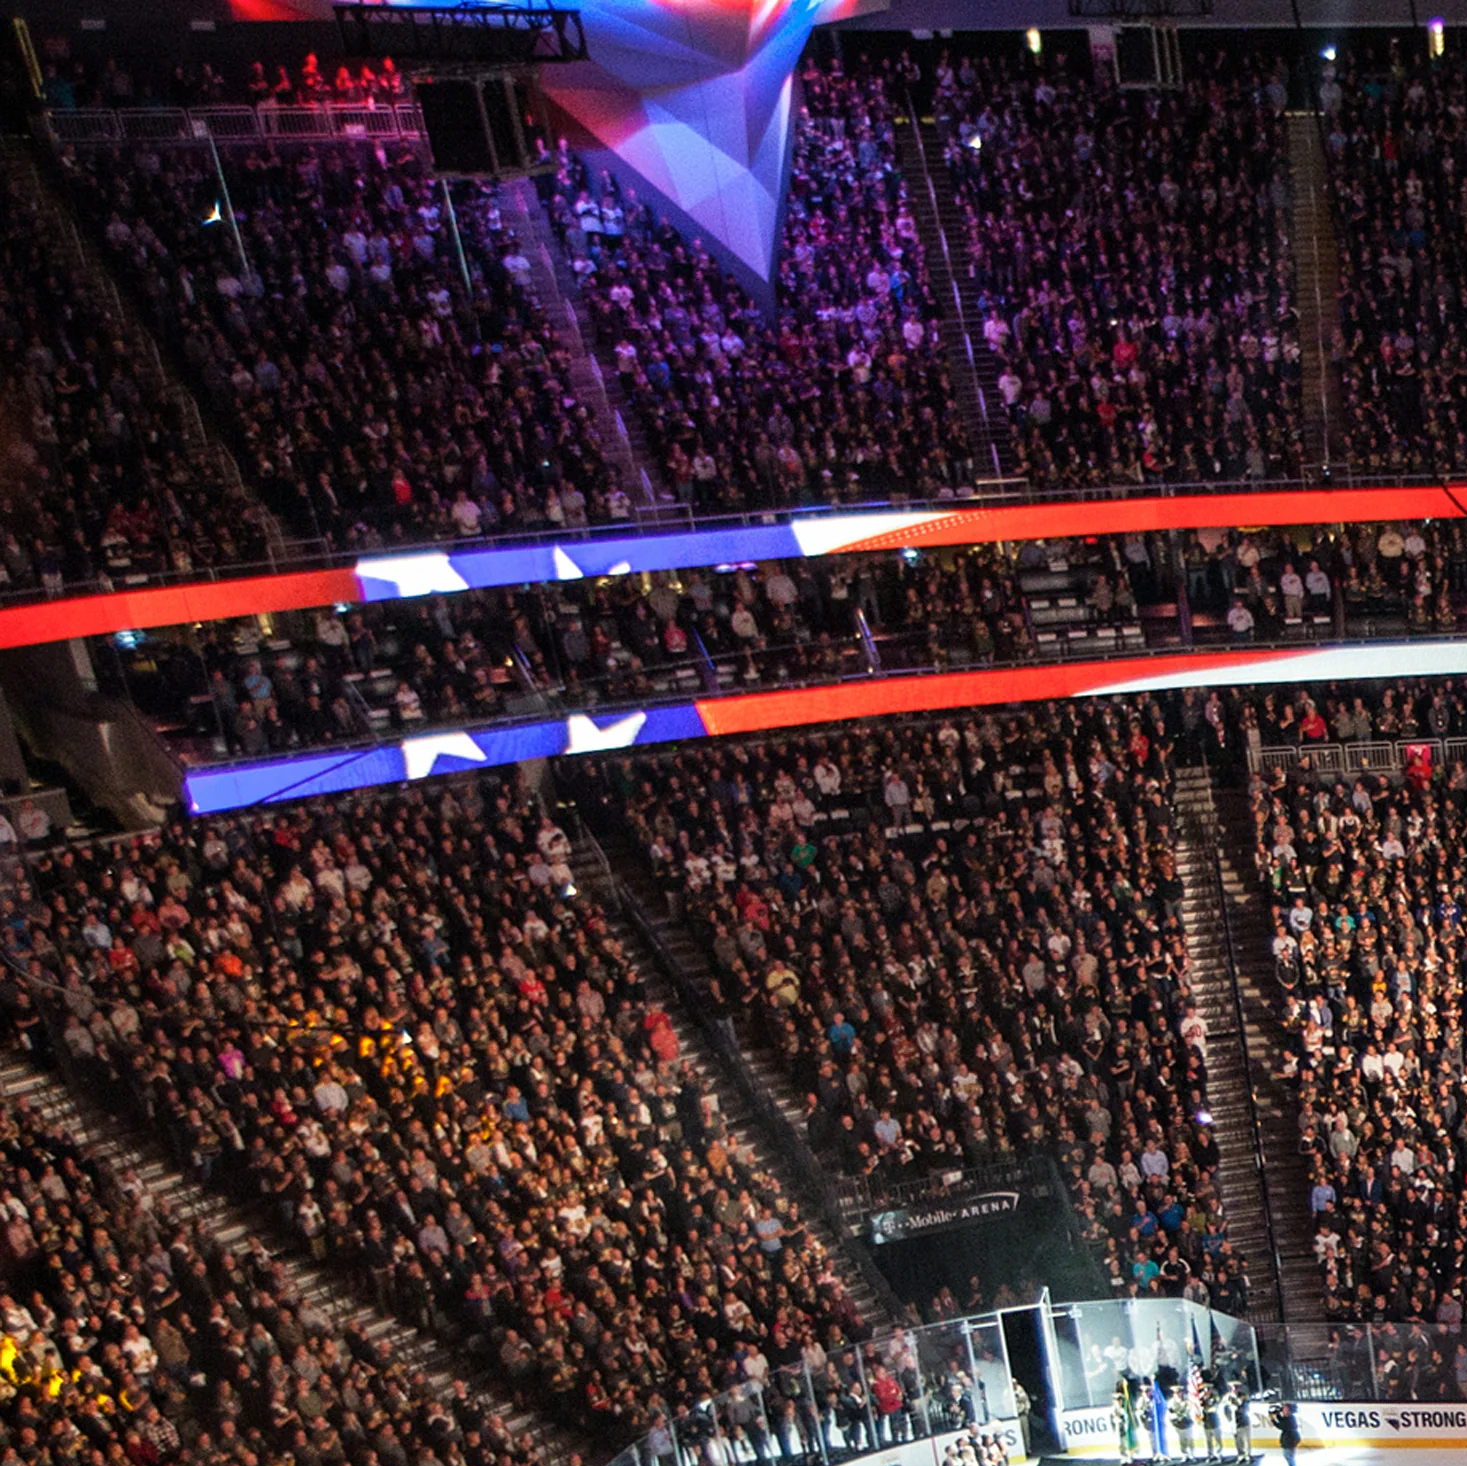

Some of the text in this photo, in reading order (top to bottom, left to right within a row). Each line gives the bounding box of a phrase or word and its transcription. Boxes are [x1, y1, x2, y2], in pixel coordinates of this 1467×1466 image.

[961, 1201, 1010, 1218] ARENA
[1321, 1411, 1467, 1429] VEGAS STRONG
